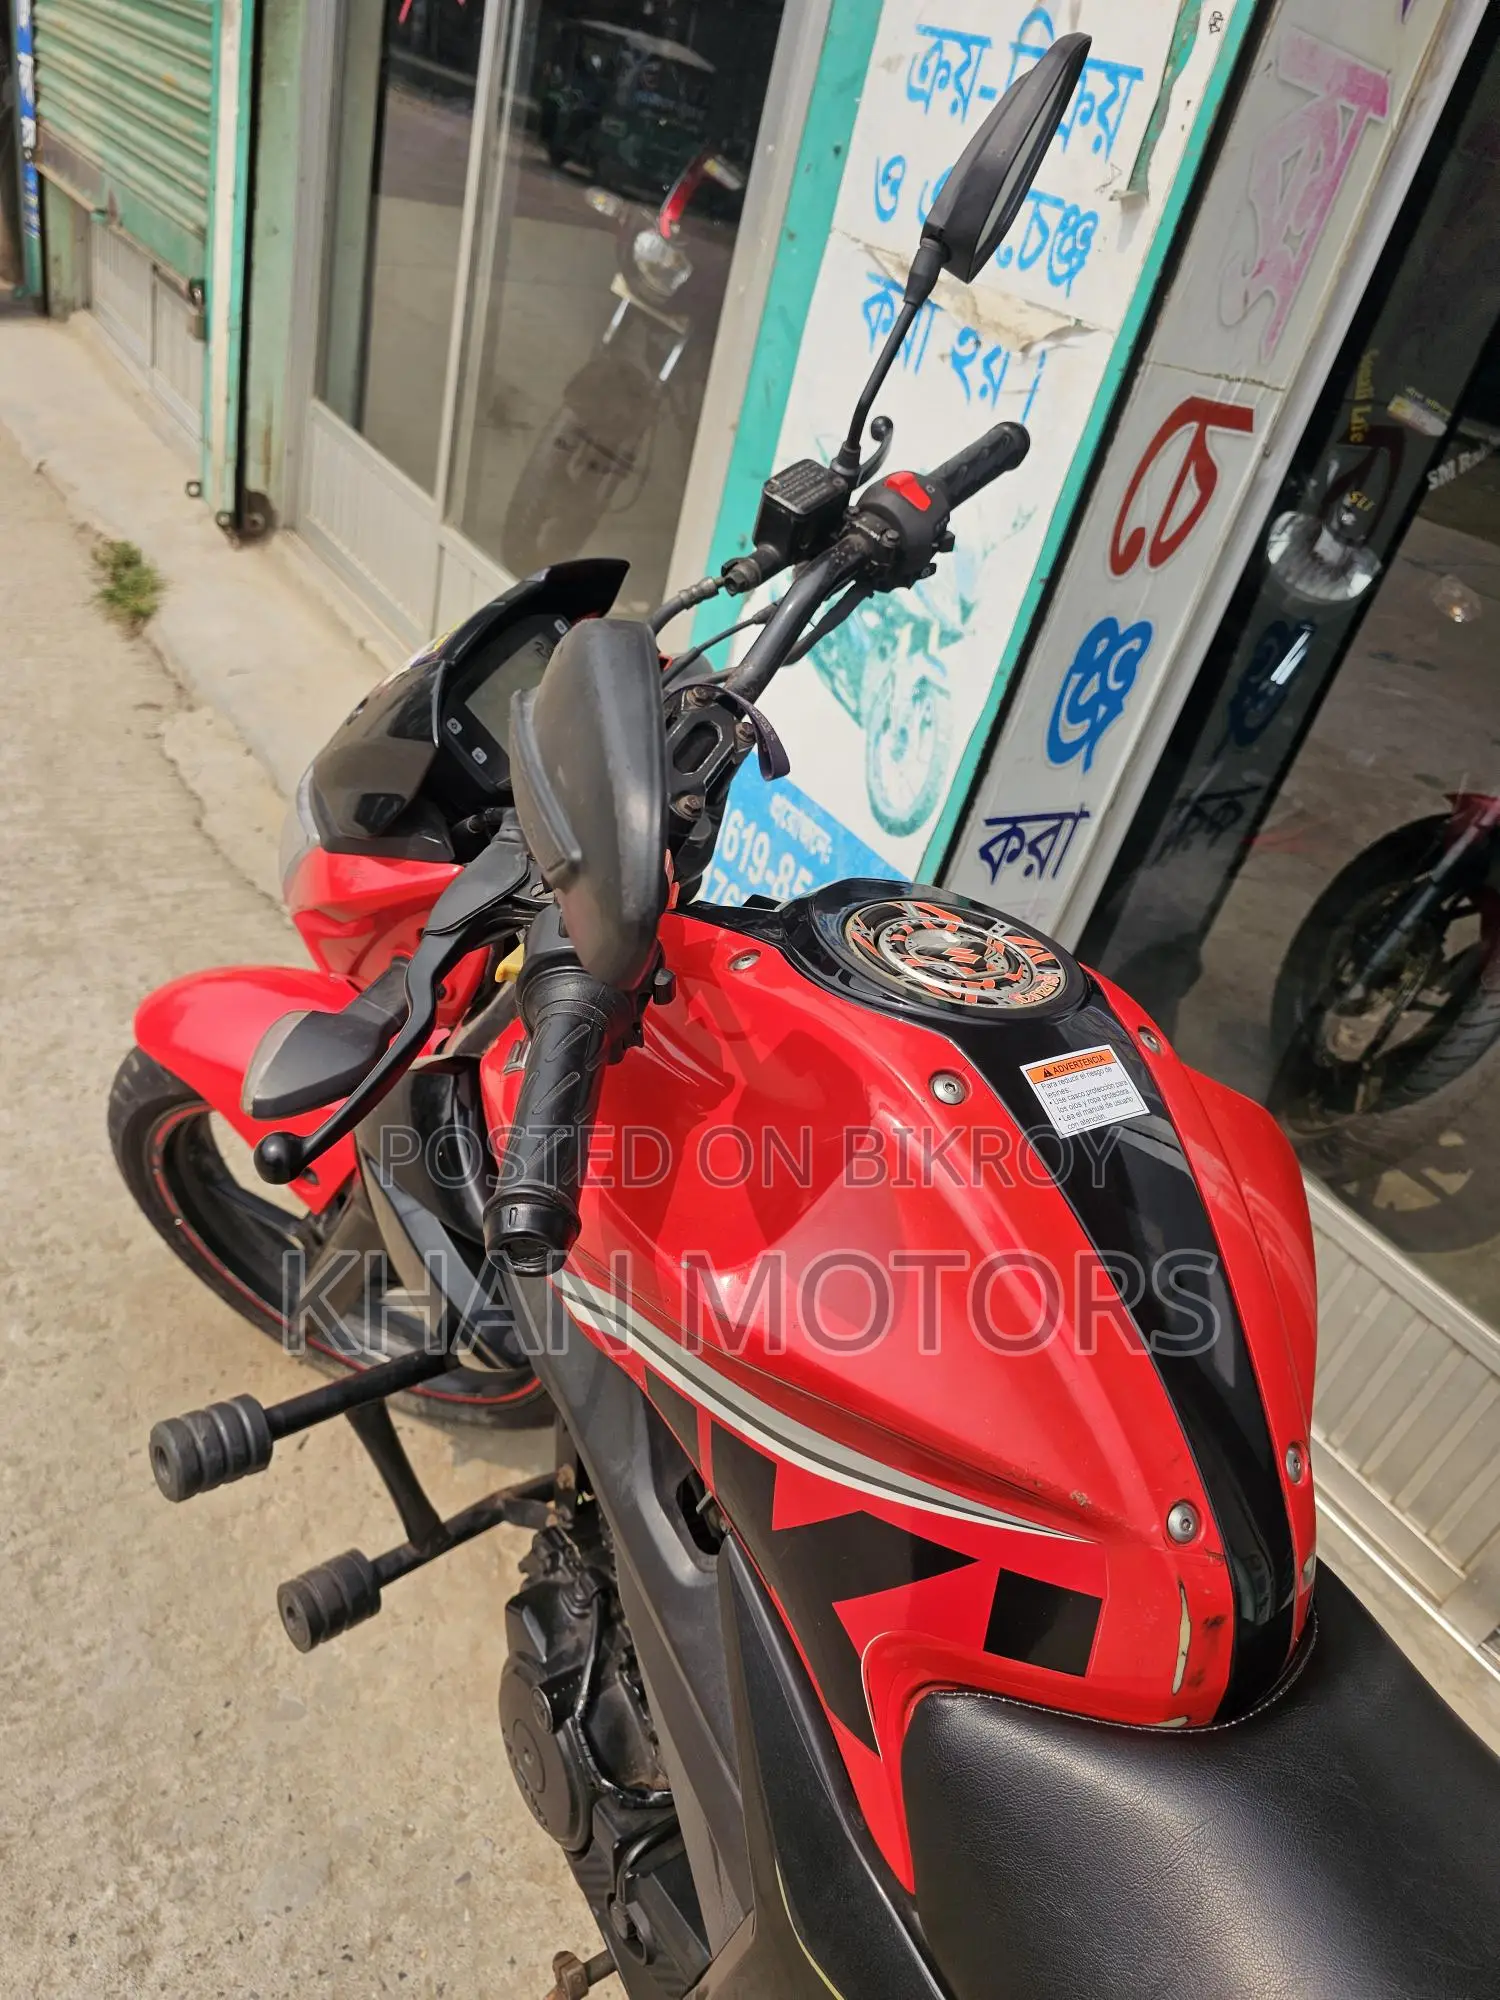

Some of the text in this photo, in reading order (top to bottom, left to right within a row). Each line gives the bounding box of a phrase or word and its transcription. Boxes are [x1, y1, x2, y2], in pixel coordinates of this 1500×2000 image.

[874, 154, 906, 223] ও
[978, 803, 1090, 886] করা
[1053, 1055, 1106, 1075] ADVERTENCIA
[1041, 1080, 1058, 1090] Para
[1053, 1096, 1066, 1106] Use
[1062, 1112, 1076, 1123] Lea
[1067, 1122, 1079, 1131] con
